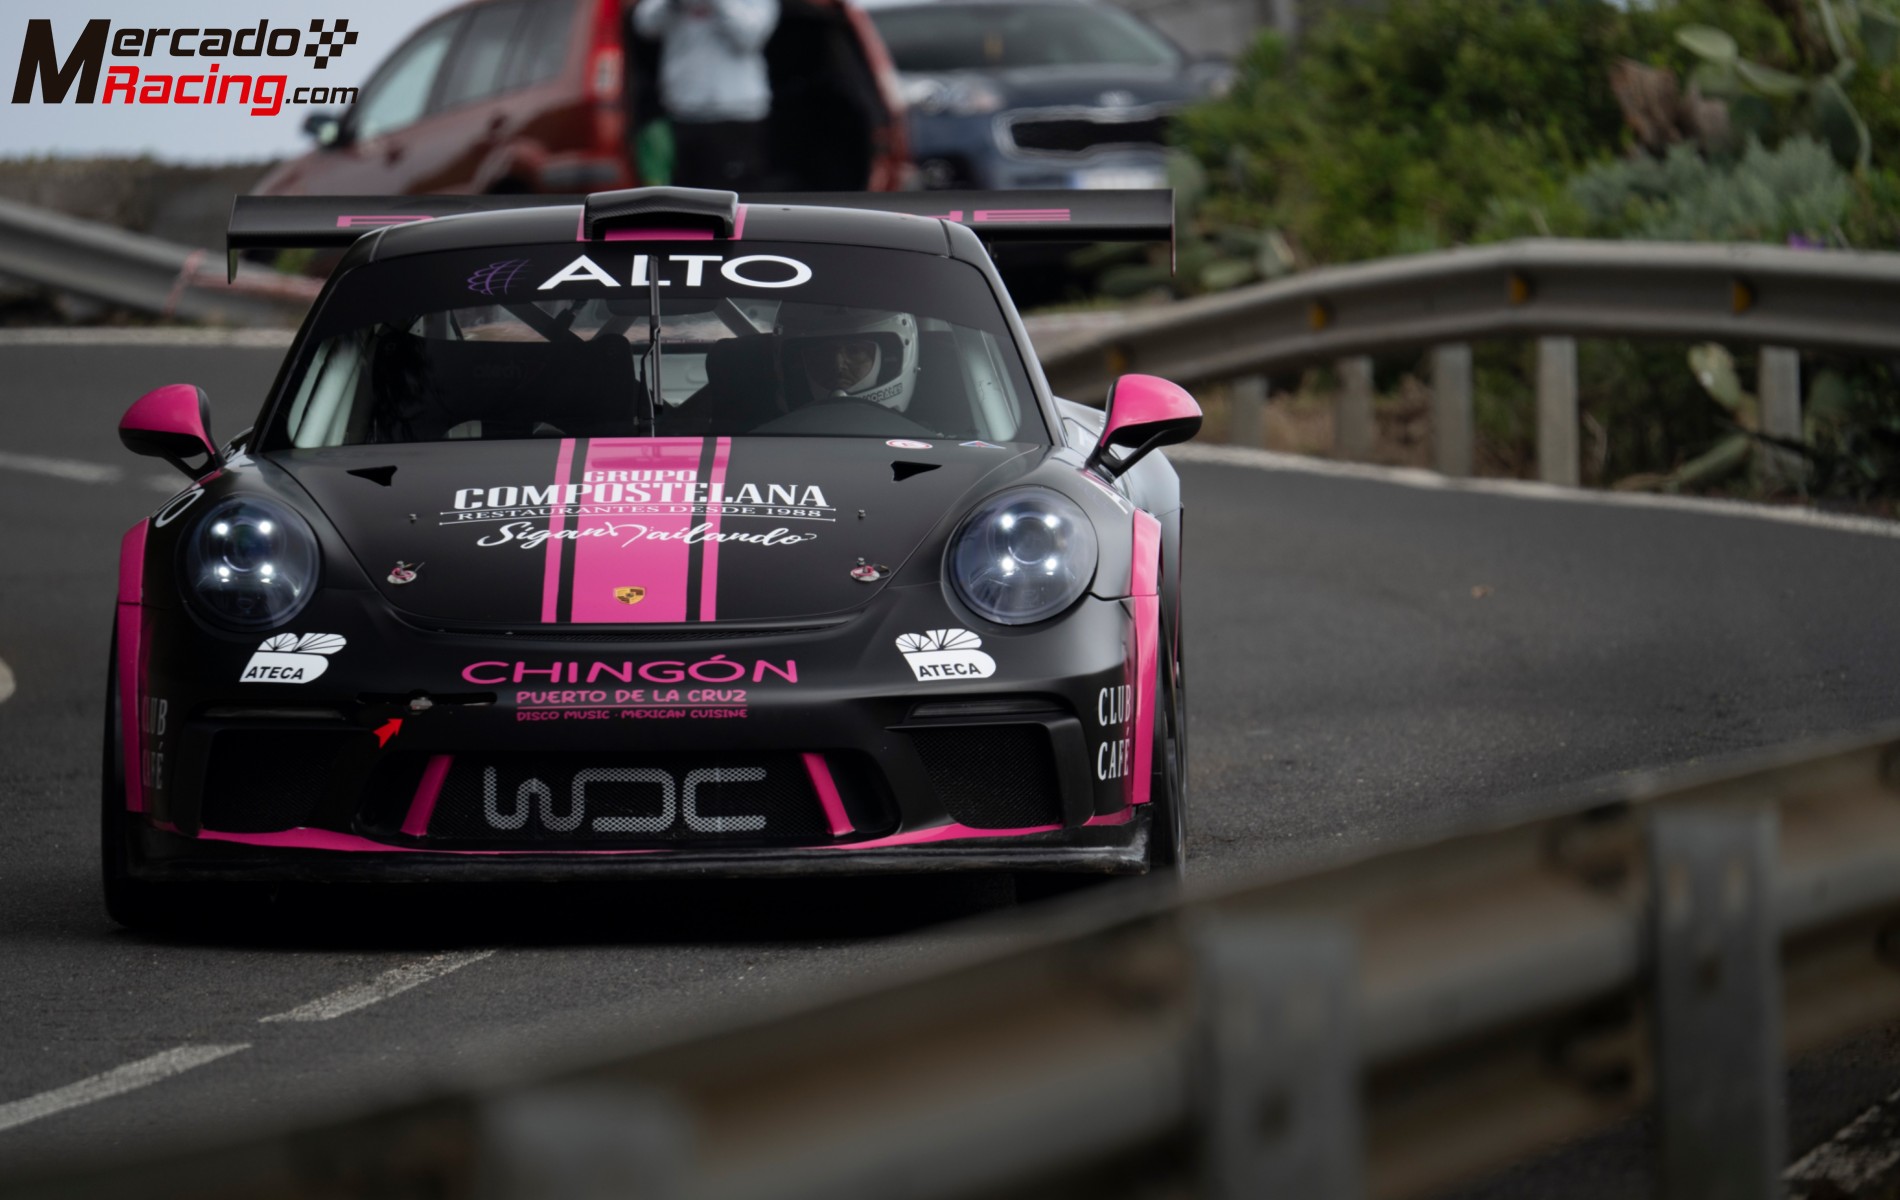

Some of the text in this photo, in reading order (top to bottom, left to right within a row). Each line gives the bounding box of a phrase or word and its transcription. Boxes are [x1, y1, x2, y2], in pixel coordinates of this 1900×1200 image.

[537, 254, 813, 290] ALTO
[583, 470, 697, 483] GRUPO
[454, 482, 830, 510] COMPOSTELANA
[458, 505, 822, 521] RESTAURANTES DESDE 1988
[245, 666, 304, 680] ATECA
[461, 654, 799, 685] CHINGÓN
[919, 663, 981, 678] ATECA
[516, 689, 747, 704] PUERTO DE LA CRUZ
[1097, 684, 1131, 727] CLUB
[516, 709, 748, 721] DISCO MUSIC MEXICAN CUISINE
[1097, 726, 1131, 781] CAFÉ
